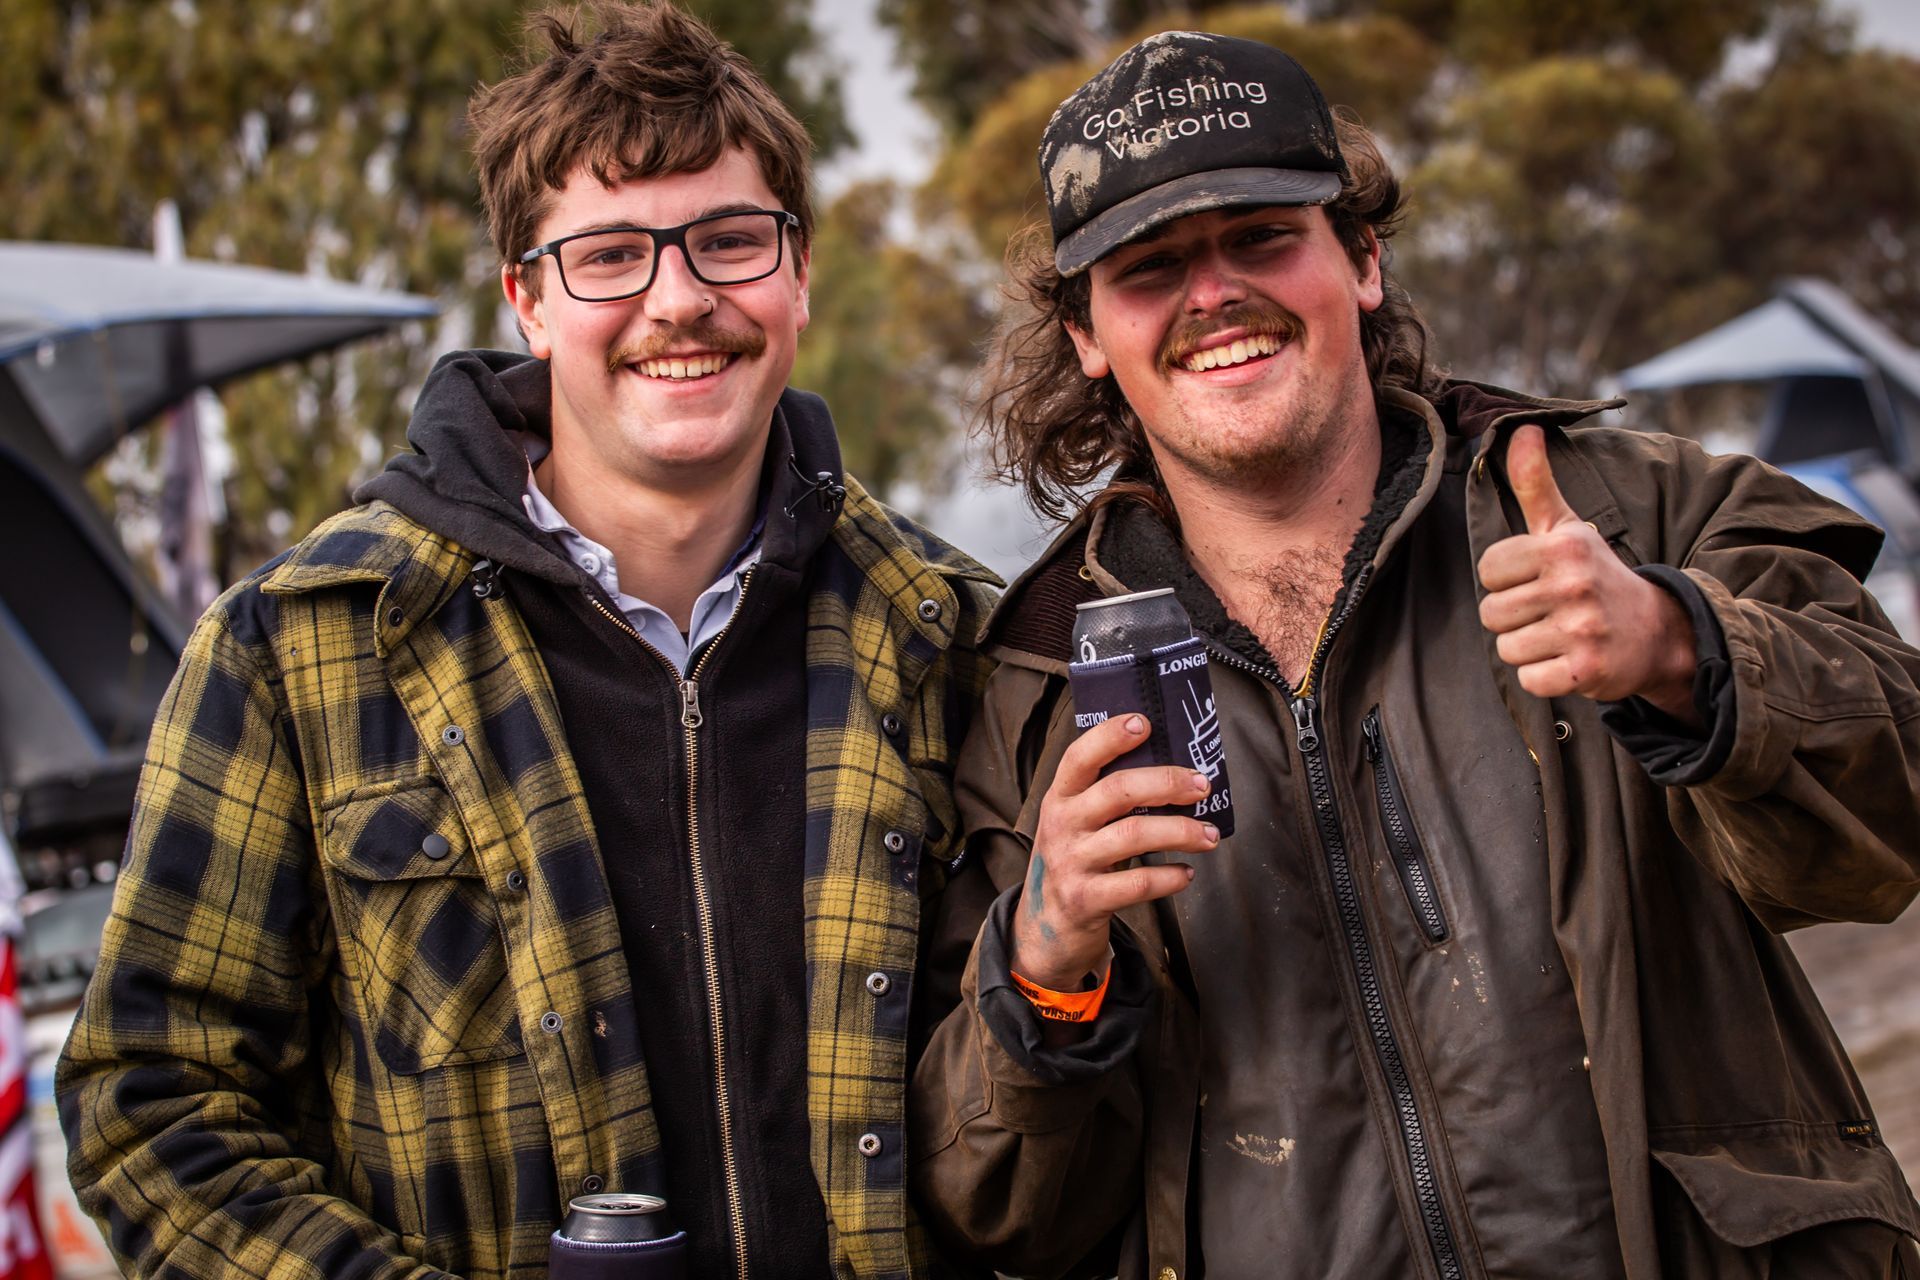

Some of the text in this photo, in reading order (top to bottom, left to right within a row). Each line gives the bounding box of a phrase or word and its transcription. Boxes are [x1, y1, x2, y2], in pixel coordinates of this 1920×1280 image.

[1082, 77, 1267, 141] Go Fishing
[1105, 107, 1251, 160] Victoria
